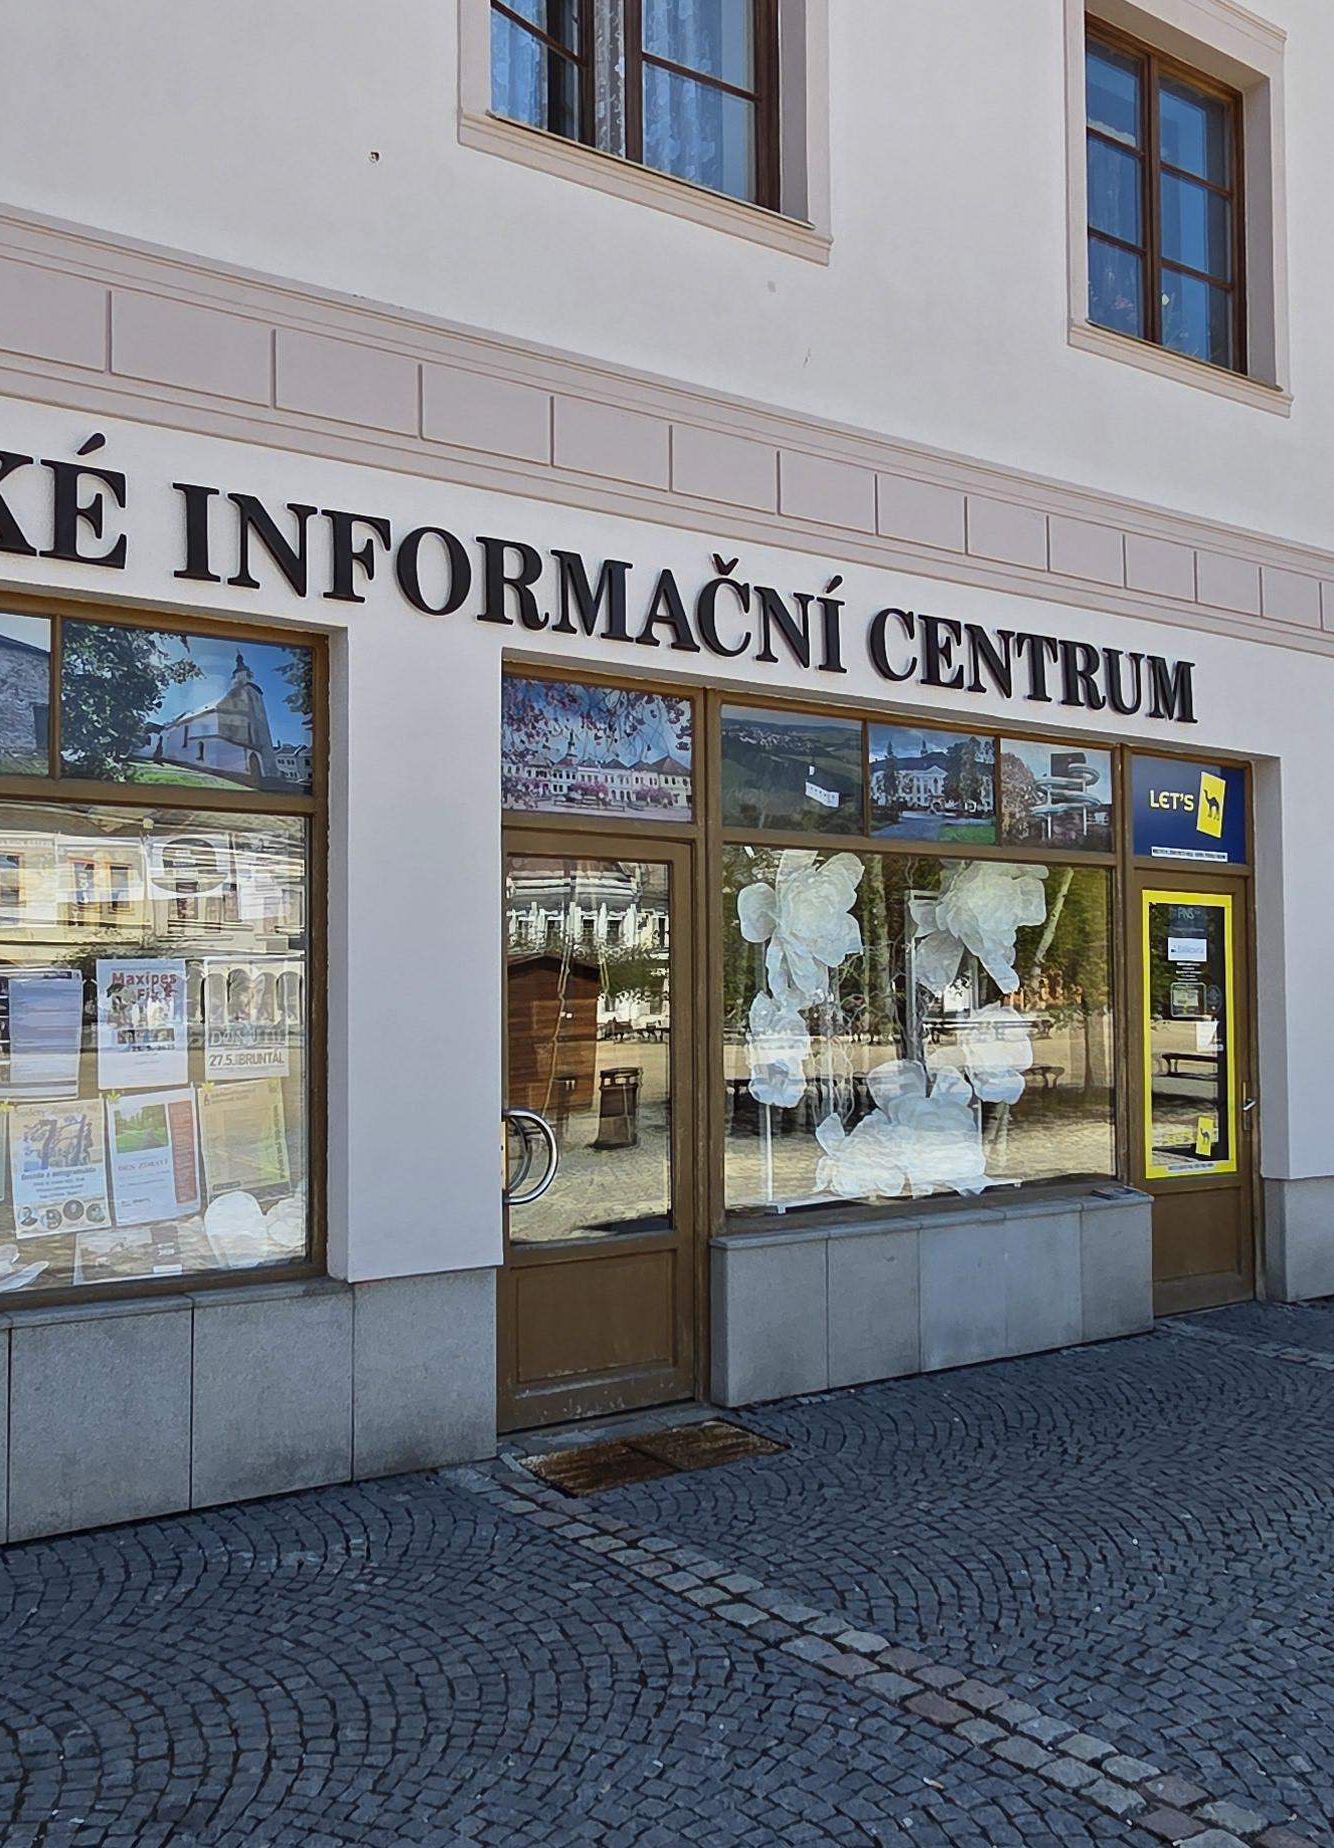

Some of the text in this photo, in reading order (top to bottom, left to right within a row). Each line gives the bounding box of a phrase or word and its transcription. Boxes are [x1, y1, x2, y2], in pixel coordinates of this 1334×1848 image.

[171, 482, 847, 674] INFORMAČNÍ
[868, 607, 1199, 725] CENTRUM
[1150, 789, 1195, 812] LET'S
[112, 971, 178, 986] Maxipes
